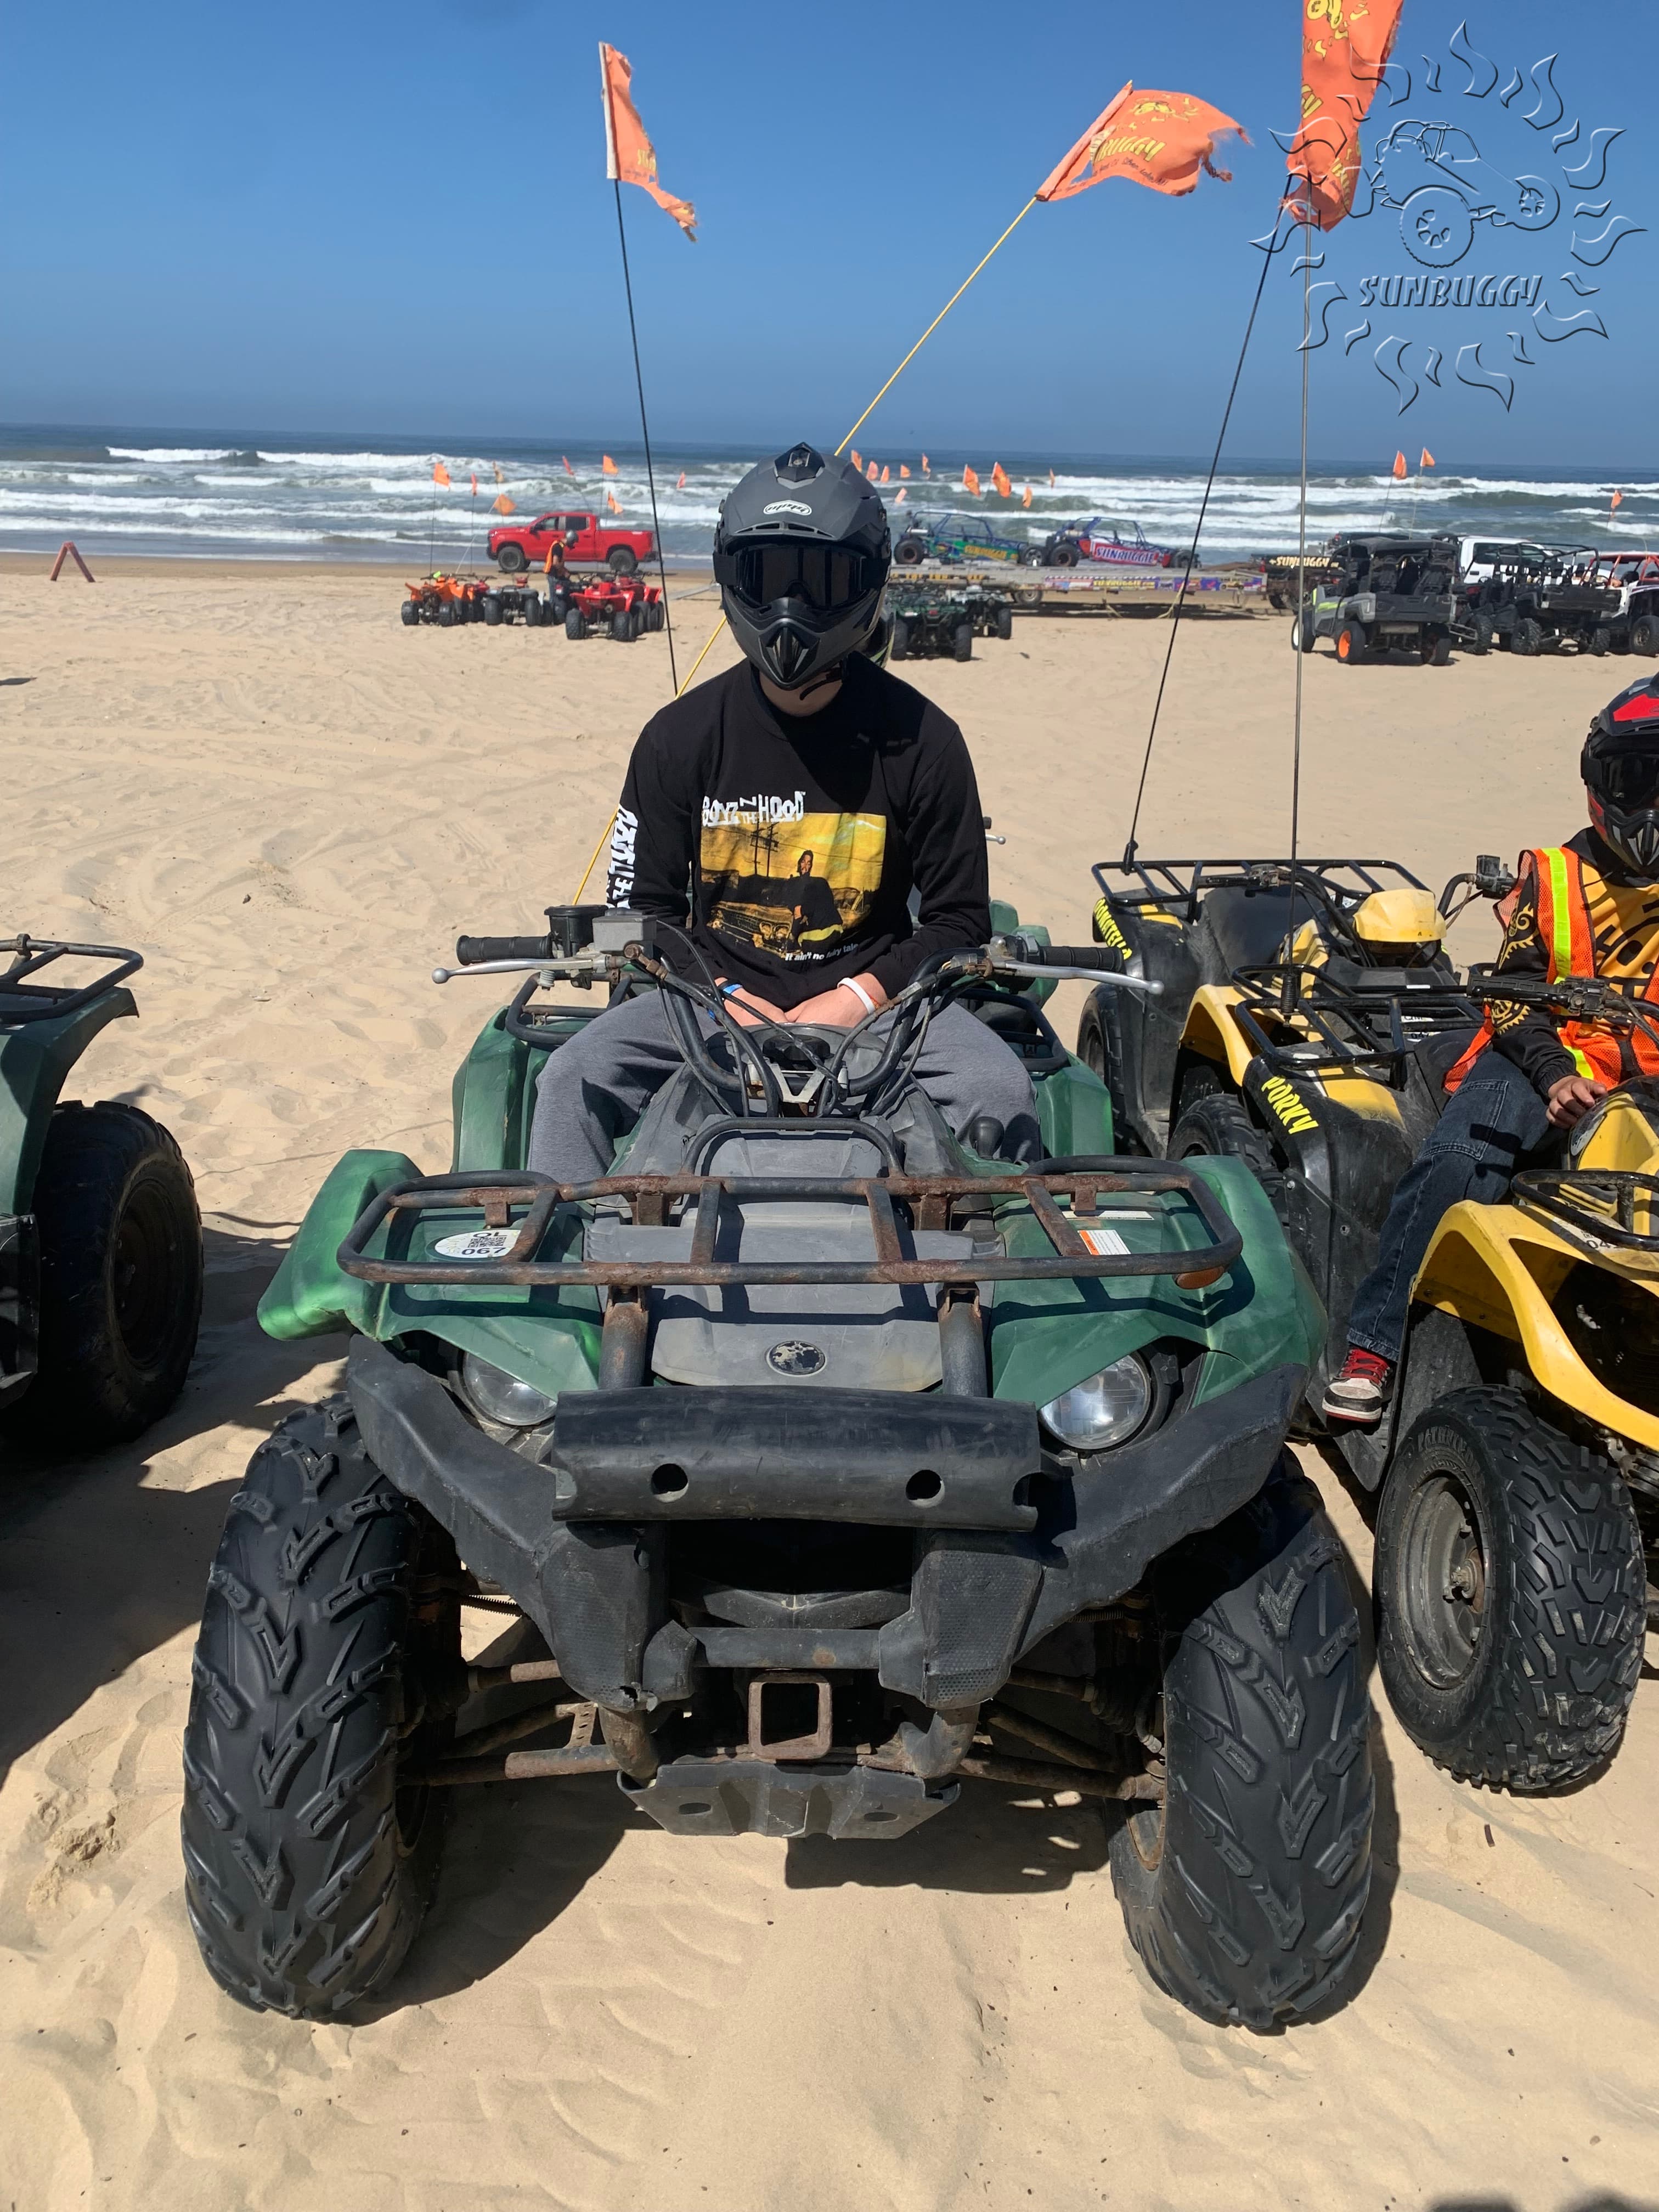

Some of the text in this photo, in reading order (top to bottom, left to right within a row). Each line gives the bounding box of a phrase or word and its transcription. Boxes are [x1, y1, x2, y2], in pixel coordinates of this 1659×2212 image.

[758, 791, 804, 823] HOOD
[785, 952, 793, 961] It
[794, 952, 812, 961] ain't
[1261, 1076, 1319, 1135] PORKY
[461, 1247, 506, 1255] 067
